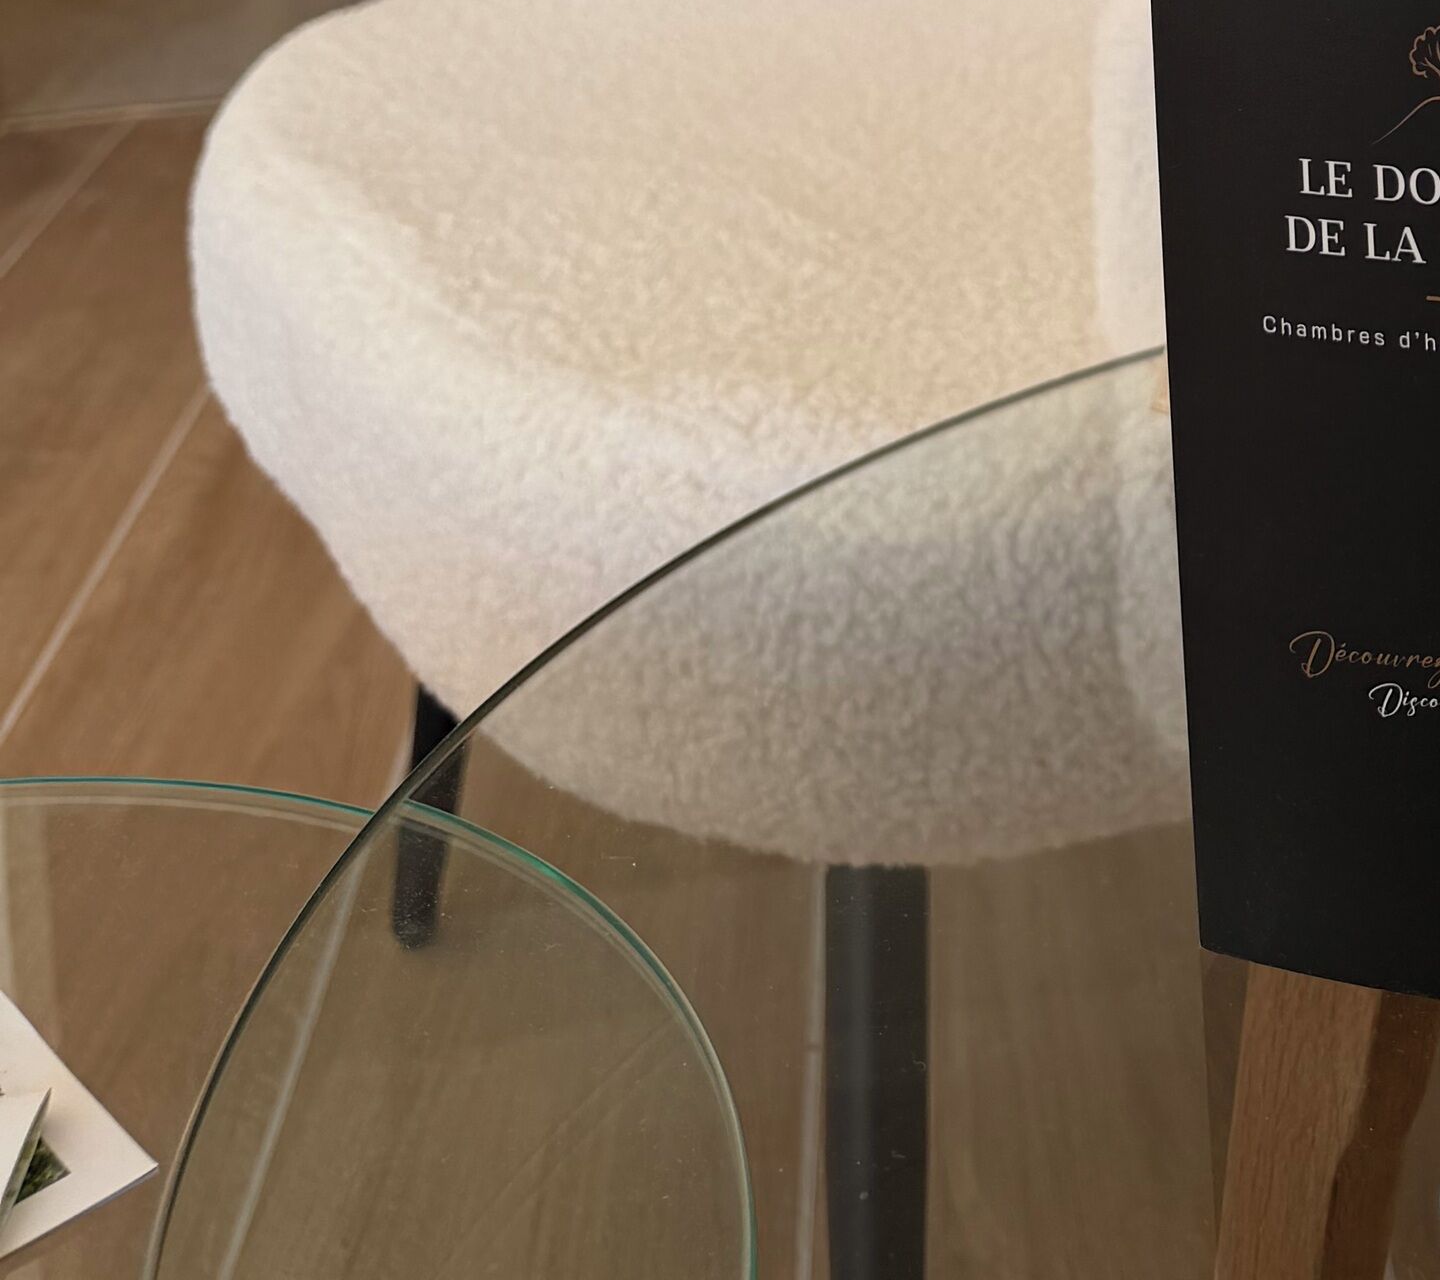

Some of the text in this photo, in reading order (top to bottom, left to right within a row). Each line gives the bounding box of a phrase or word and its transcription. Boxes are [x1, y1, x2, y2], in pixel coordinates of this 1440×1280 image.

[1299, 157, 1353, 199] LE
[1284, 214, 1346, 257] DE
[1363, 222, 1427, 265] LA
[1262, 314, 1386, 347] Chambres
